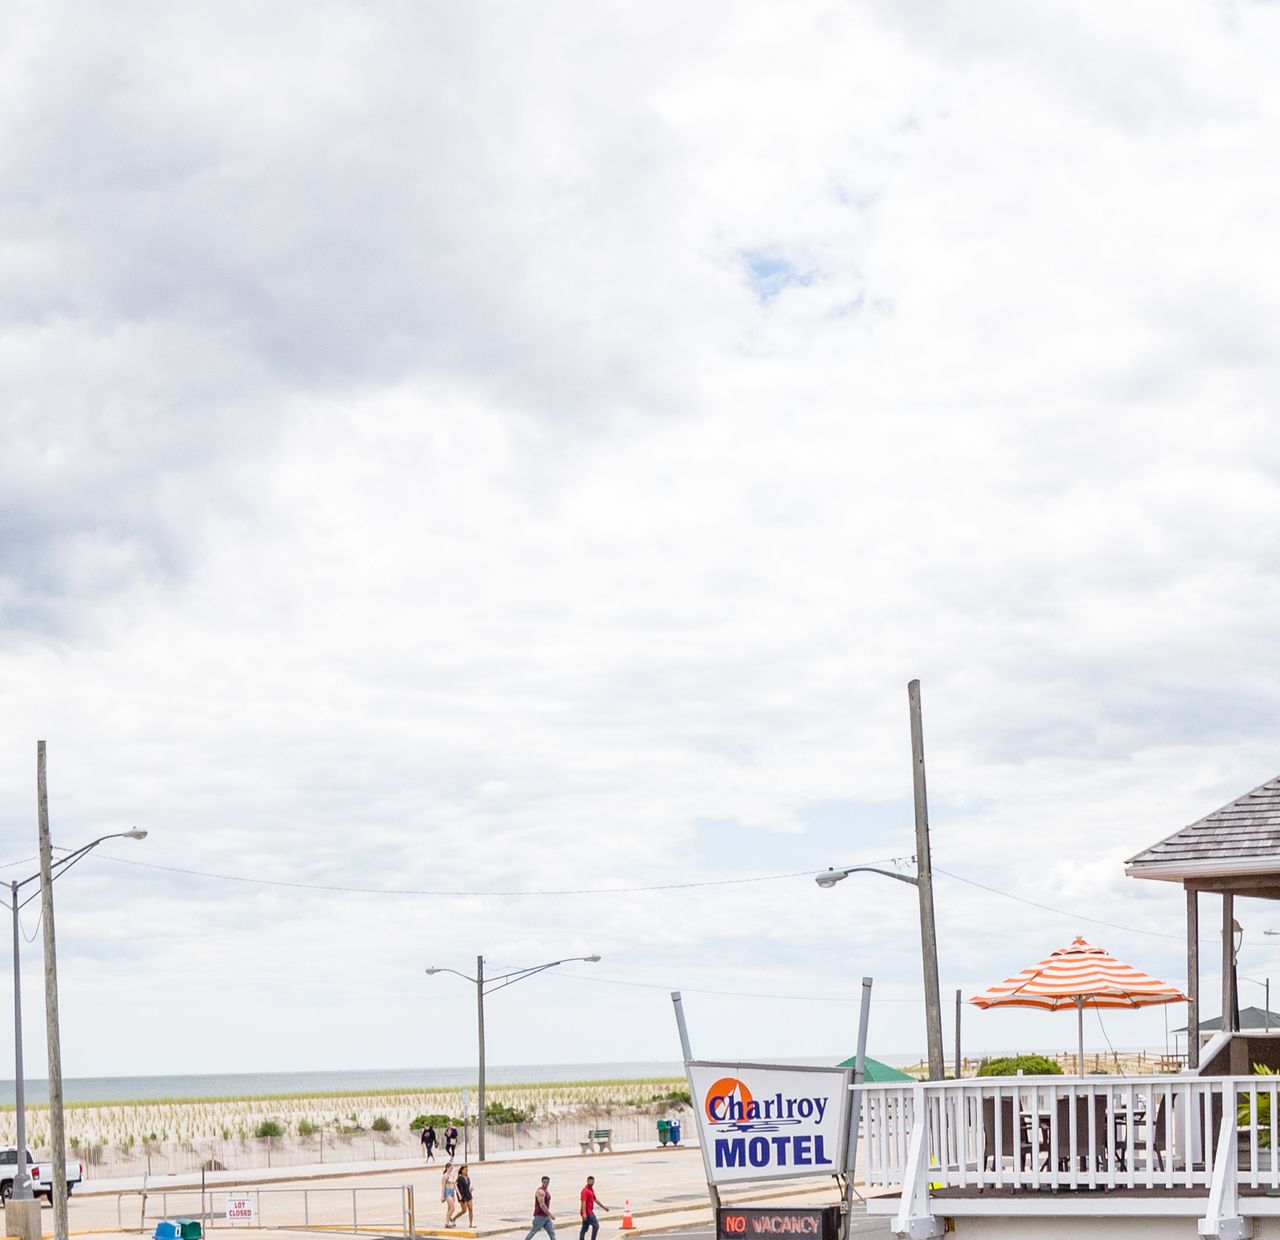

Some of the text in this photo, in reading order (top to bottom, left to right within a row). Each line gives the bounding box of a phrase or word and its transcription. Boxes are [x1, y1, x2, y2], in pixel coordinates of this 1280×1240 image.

[708, 1093, 829, 1125] Charlroy
[715, 1135, 832, 1168] MOTEL
[726, 1216, 819, 1234] NO VACANCY
